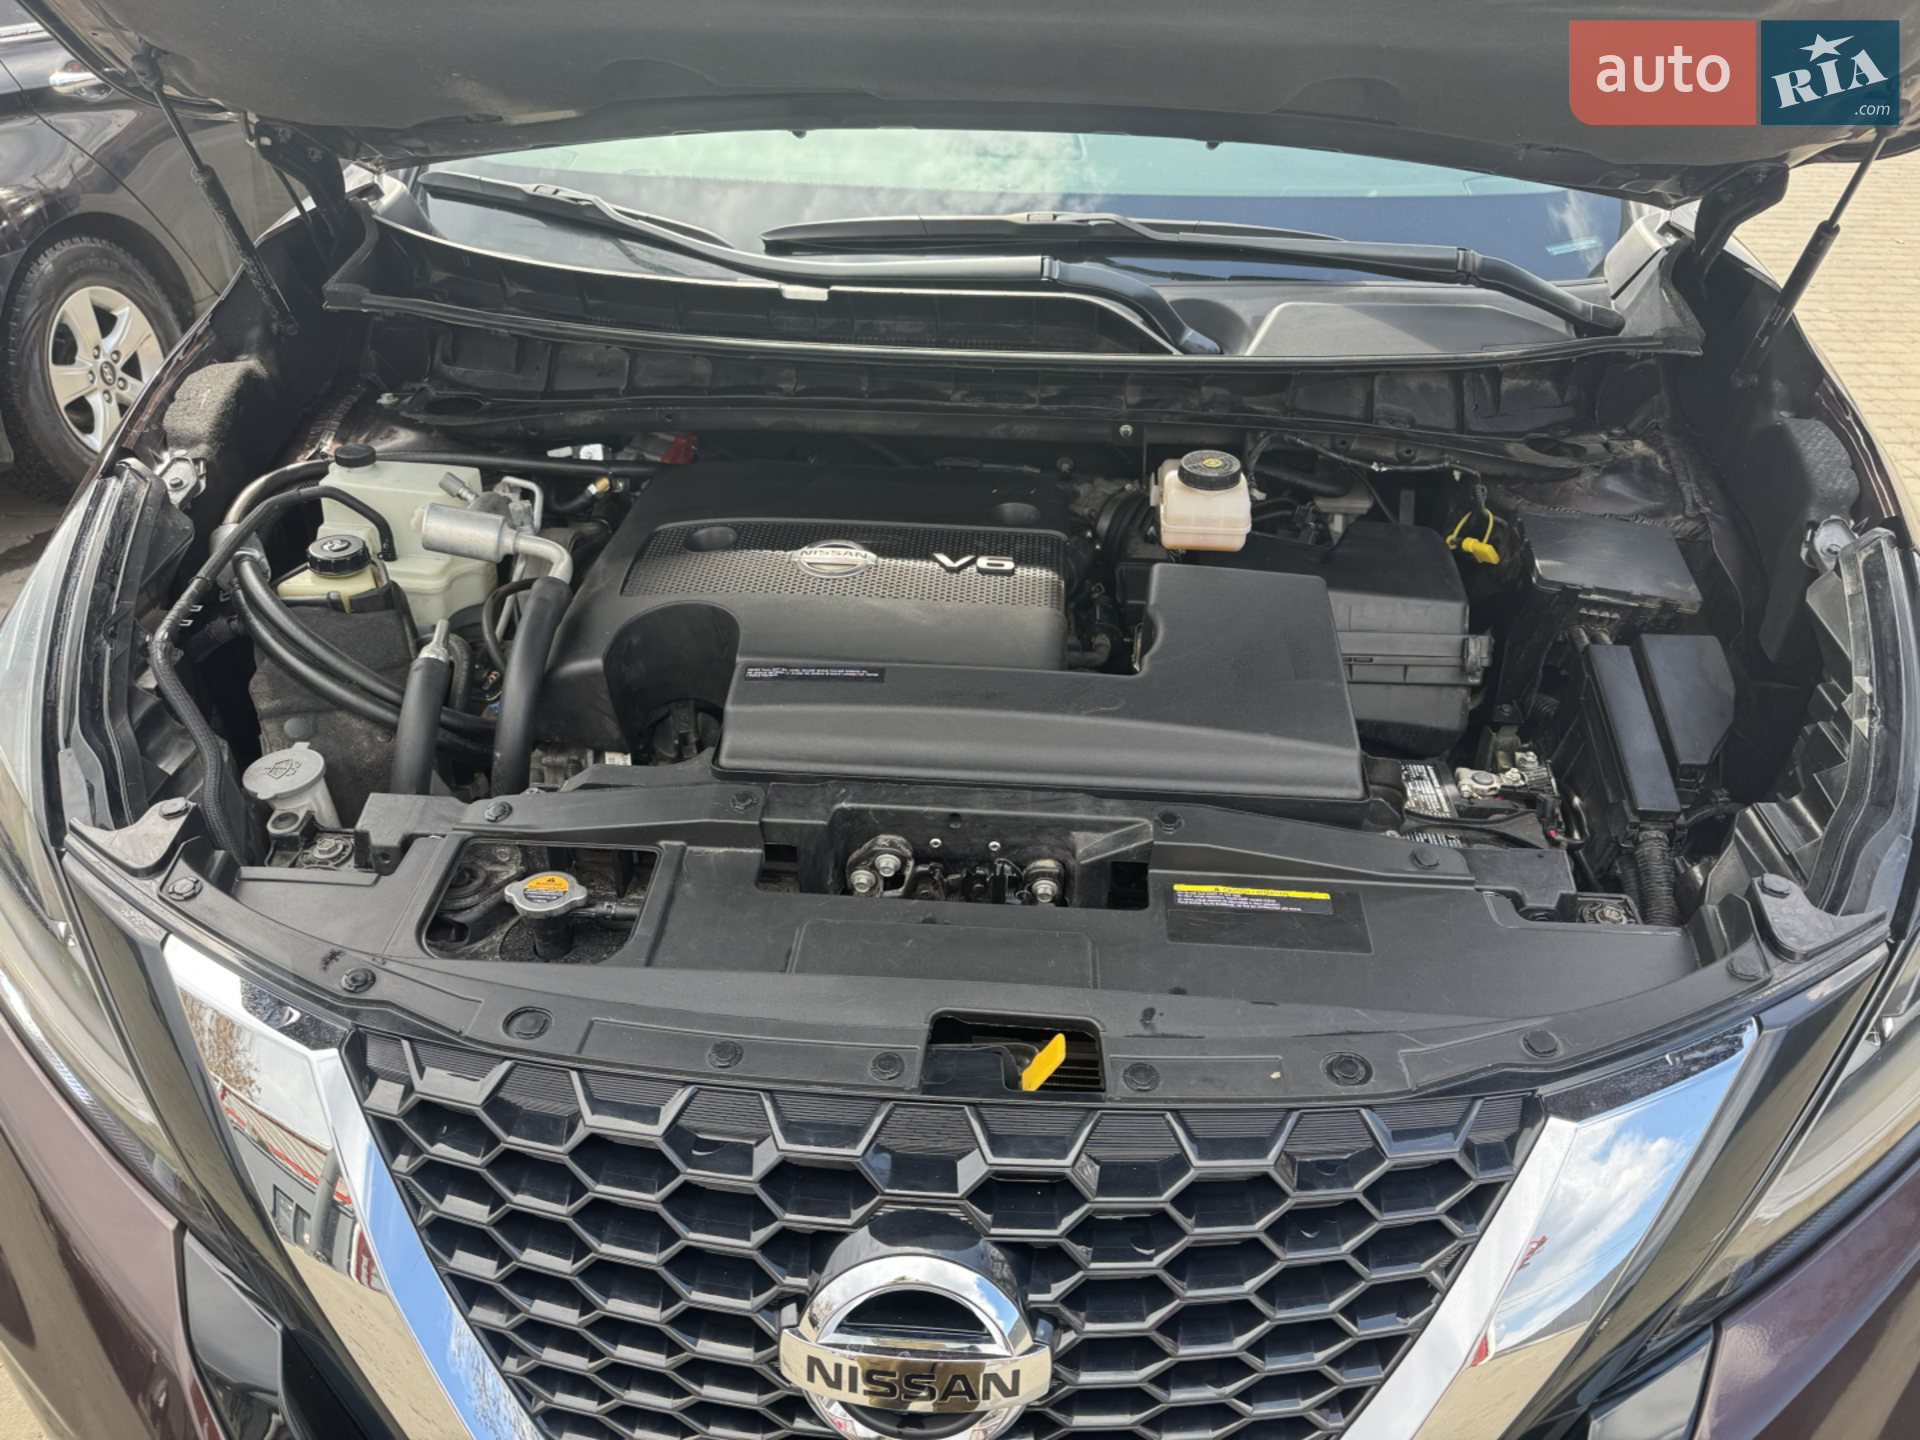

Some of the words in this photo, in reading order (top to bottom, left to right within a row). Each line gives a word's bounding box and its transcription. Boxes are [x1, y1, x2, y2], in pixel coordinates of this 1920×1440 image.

[800, 549, 868, 559] NISSAN
[932, 552, 1015, 576] V6
[806, 1354, 1021, 1403] NISSAN
